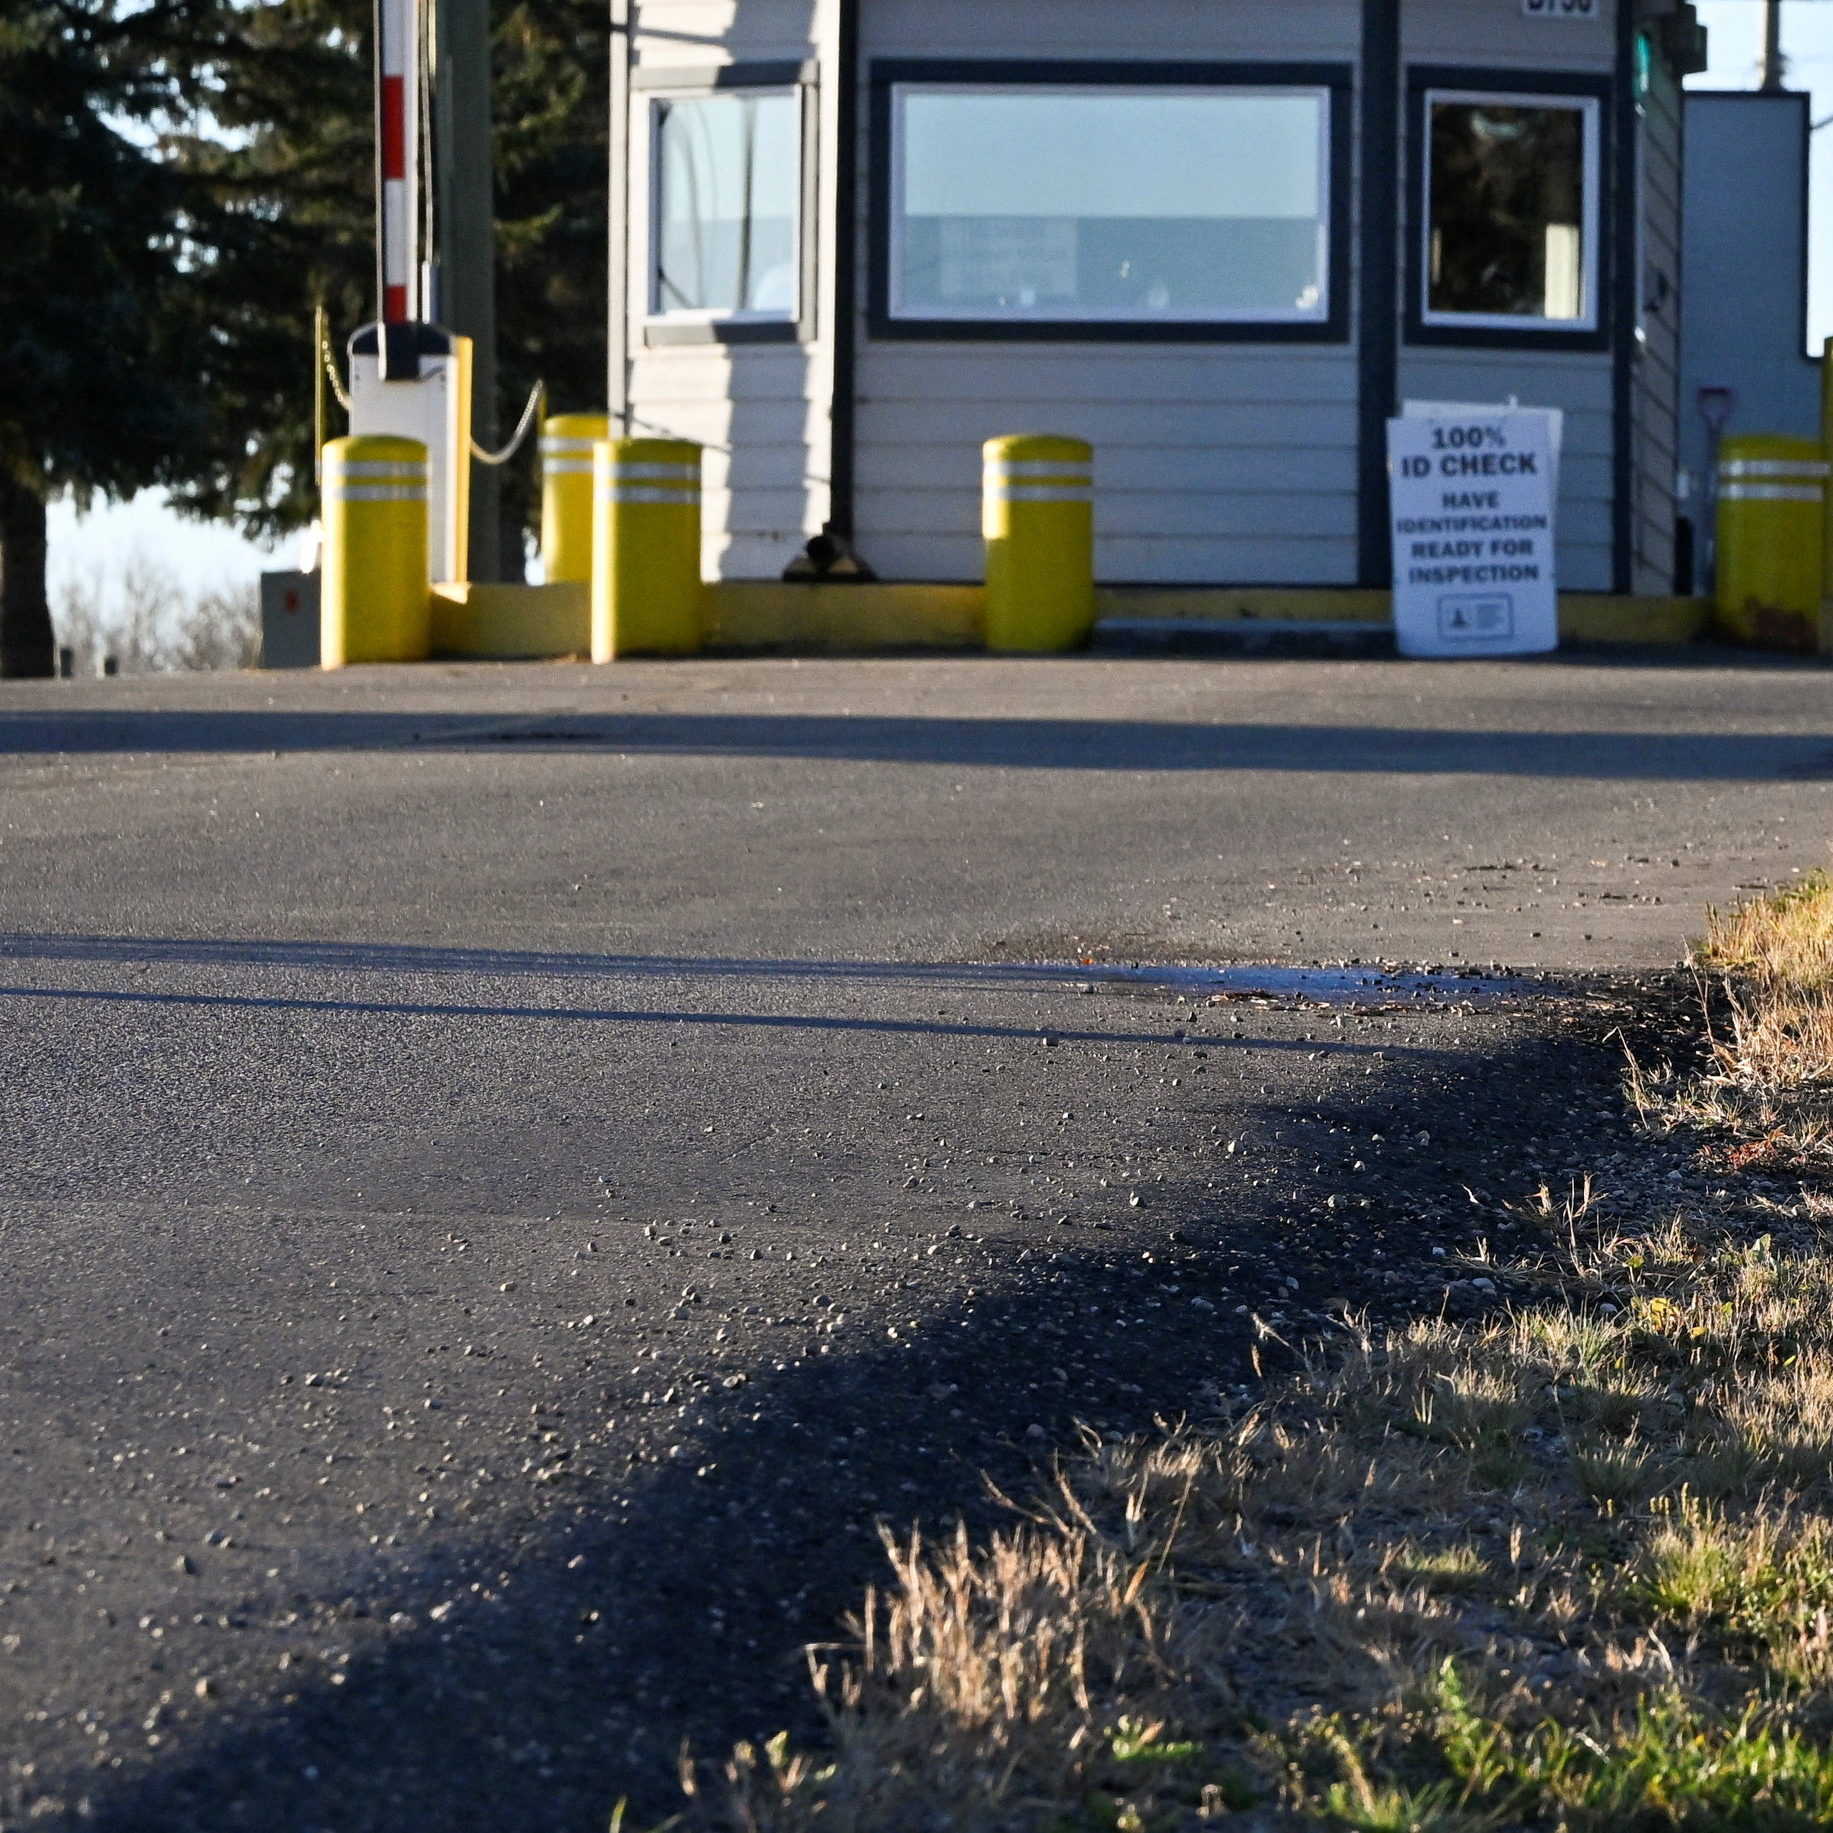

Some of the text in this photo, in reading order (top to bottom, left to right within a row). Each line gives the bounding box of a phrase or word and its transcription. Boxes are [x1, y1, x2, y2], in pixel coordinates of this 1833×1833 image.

[1432, 427, 1507, 450] 100%
[1402, 452, 1538, 478] ID CHECK
[1442, 491, 1499, 509] HAVE
[1397, 516, 1548, 534] IDENTIFICATION
[1411, 539, 1534, 559] READY FOR
[1409, 565, 1540, 584] INSPECTION
